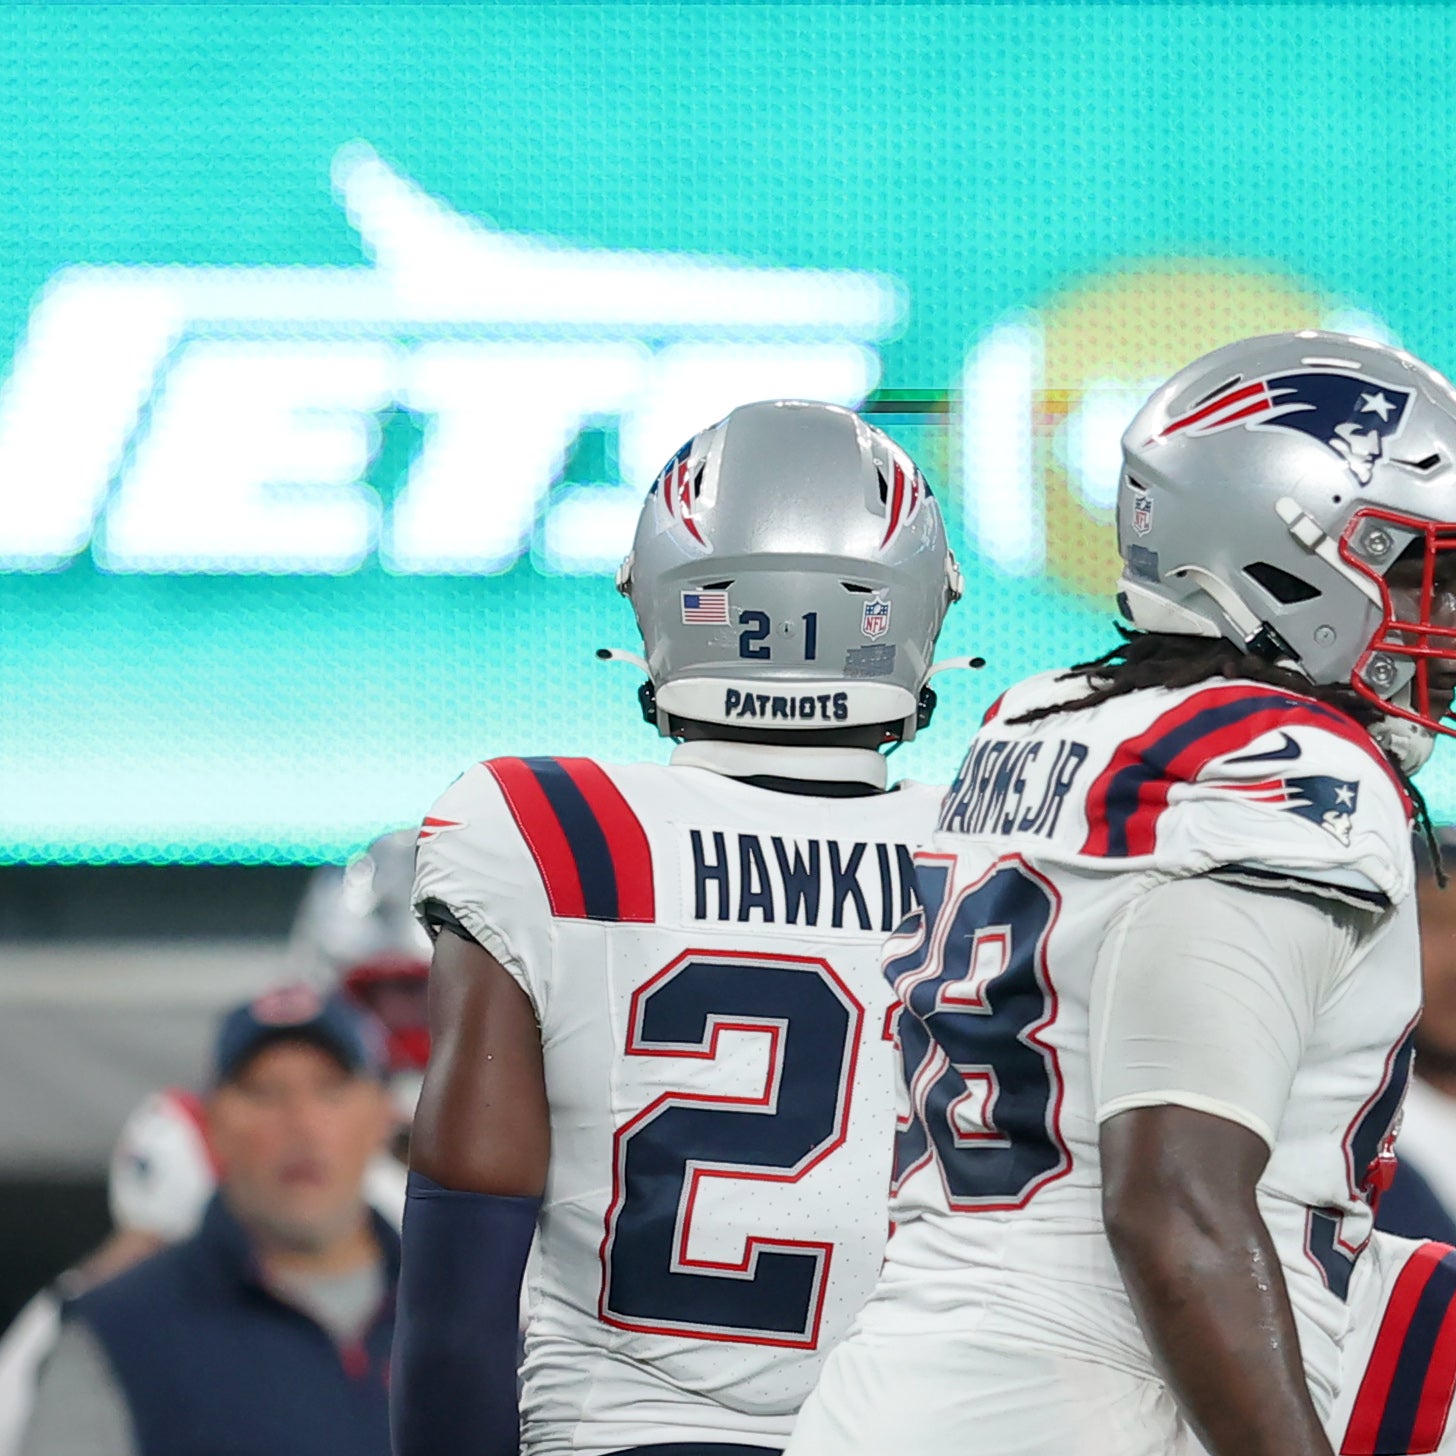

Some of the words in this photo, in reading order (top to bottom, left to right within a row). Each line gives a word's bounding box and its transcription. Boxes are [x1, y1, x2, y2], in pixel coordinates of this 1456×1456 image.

[865, 616, 886, 631] NFL
[724, 687, 848, 720] PATRIOTS
[1016, 739, 1089, 839] JR
[602, 947, 902, 1348] 2
